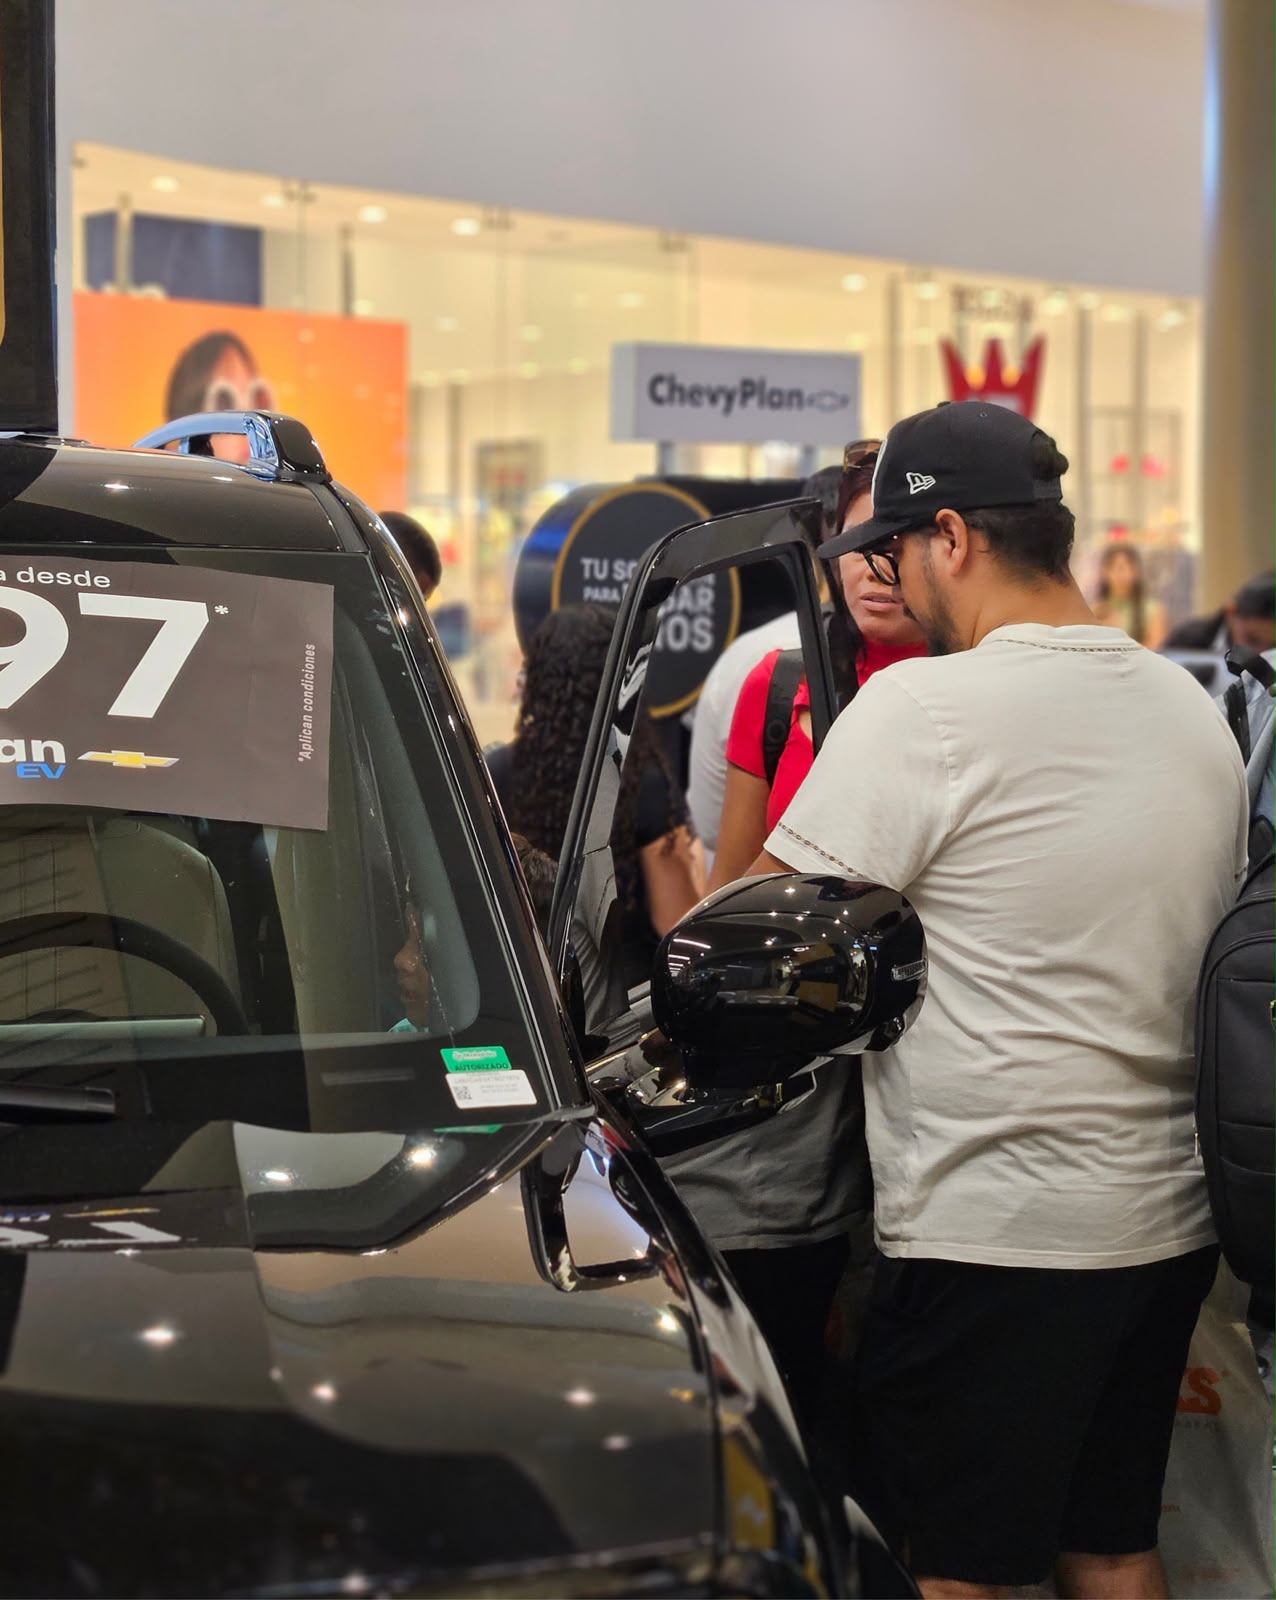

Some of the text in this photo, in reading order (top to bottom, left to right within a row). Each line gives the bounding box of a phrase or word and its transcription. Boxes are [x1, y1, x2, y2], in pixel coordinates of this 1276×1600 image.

[648, 373, 805, 417] ChevyPlan
[16, 566, 111, 588] desde
[580, 557, 609, 580] TU
[583, 586, 620, 602] PARA
[301, 643, 316, 712] condiciones
[16, 762, 67, 779] EV
[454, 1062, 510, 1072] AUTORIZADO
